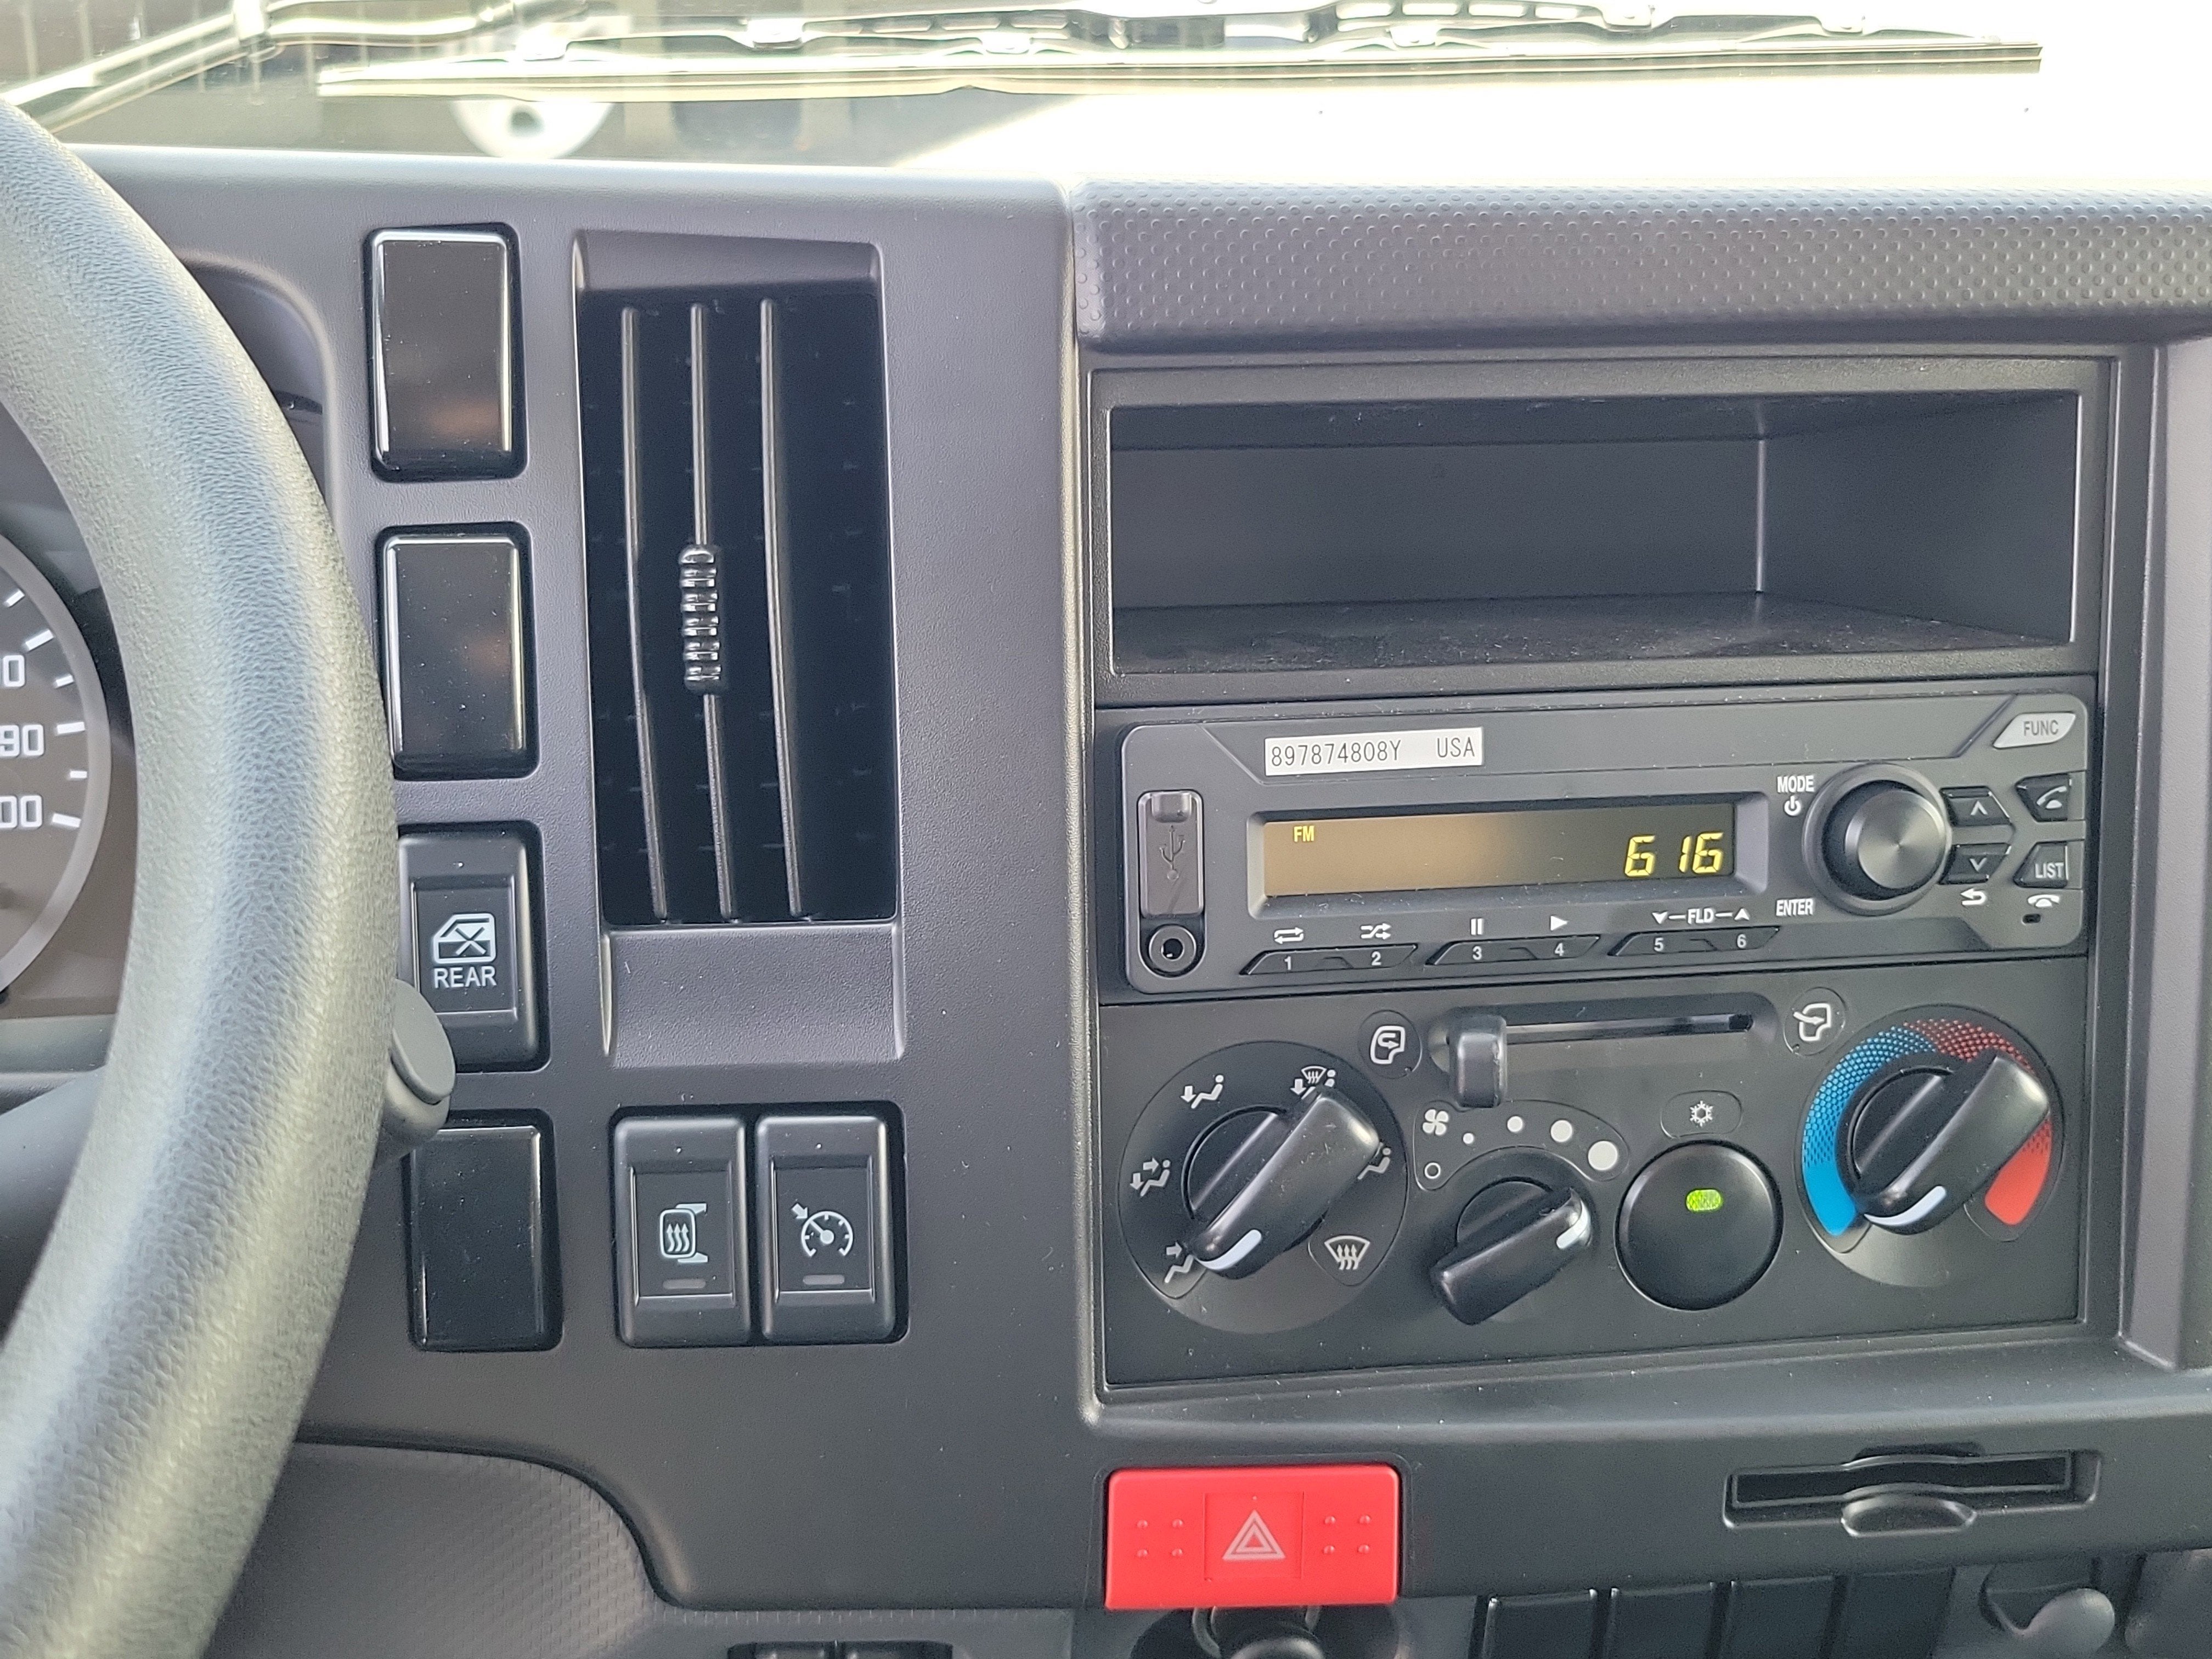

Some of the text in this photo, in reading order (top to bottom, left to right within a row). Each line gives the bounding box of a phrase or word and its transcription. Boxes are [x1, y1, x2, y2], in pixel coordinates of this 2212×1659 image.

[2023, 720, 2059, 736] FUNC
[1271, 737, 1475, 766] 897874808Y USA
[1776, 775, 1815, 793] MODE
[1294, 826, 1314, 842] FM
[2034, 861, 2064, 879] LIST
[1776, 898, 1814, 916] ENTER
[1687, 909, 1714, 925] FLD
[1654, 937, 1664, 952] 5
[1736, 933, 1747, 949] 6
[1472, 946, 1483, 961] 3
[1554, 943, 1565, 957] 4
[1284, 956, 1293, 971] 1
[1370, 951, 1382, 967] 2
[433, 966, 496, 988] REAR
